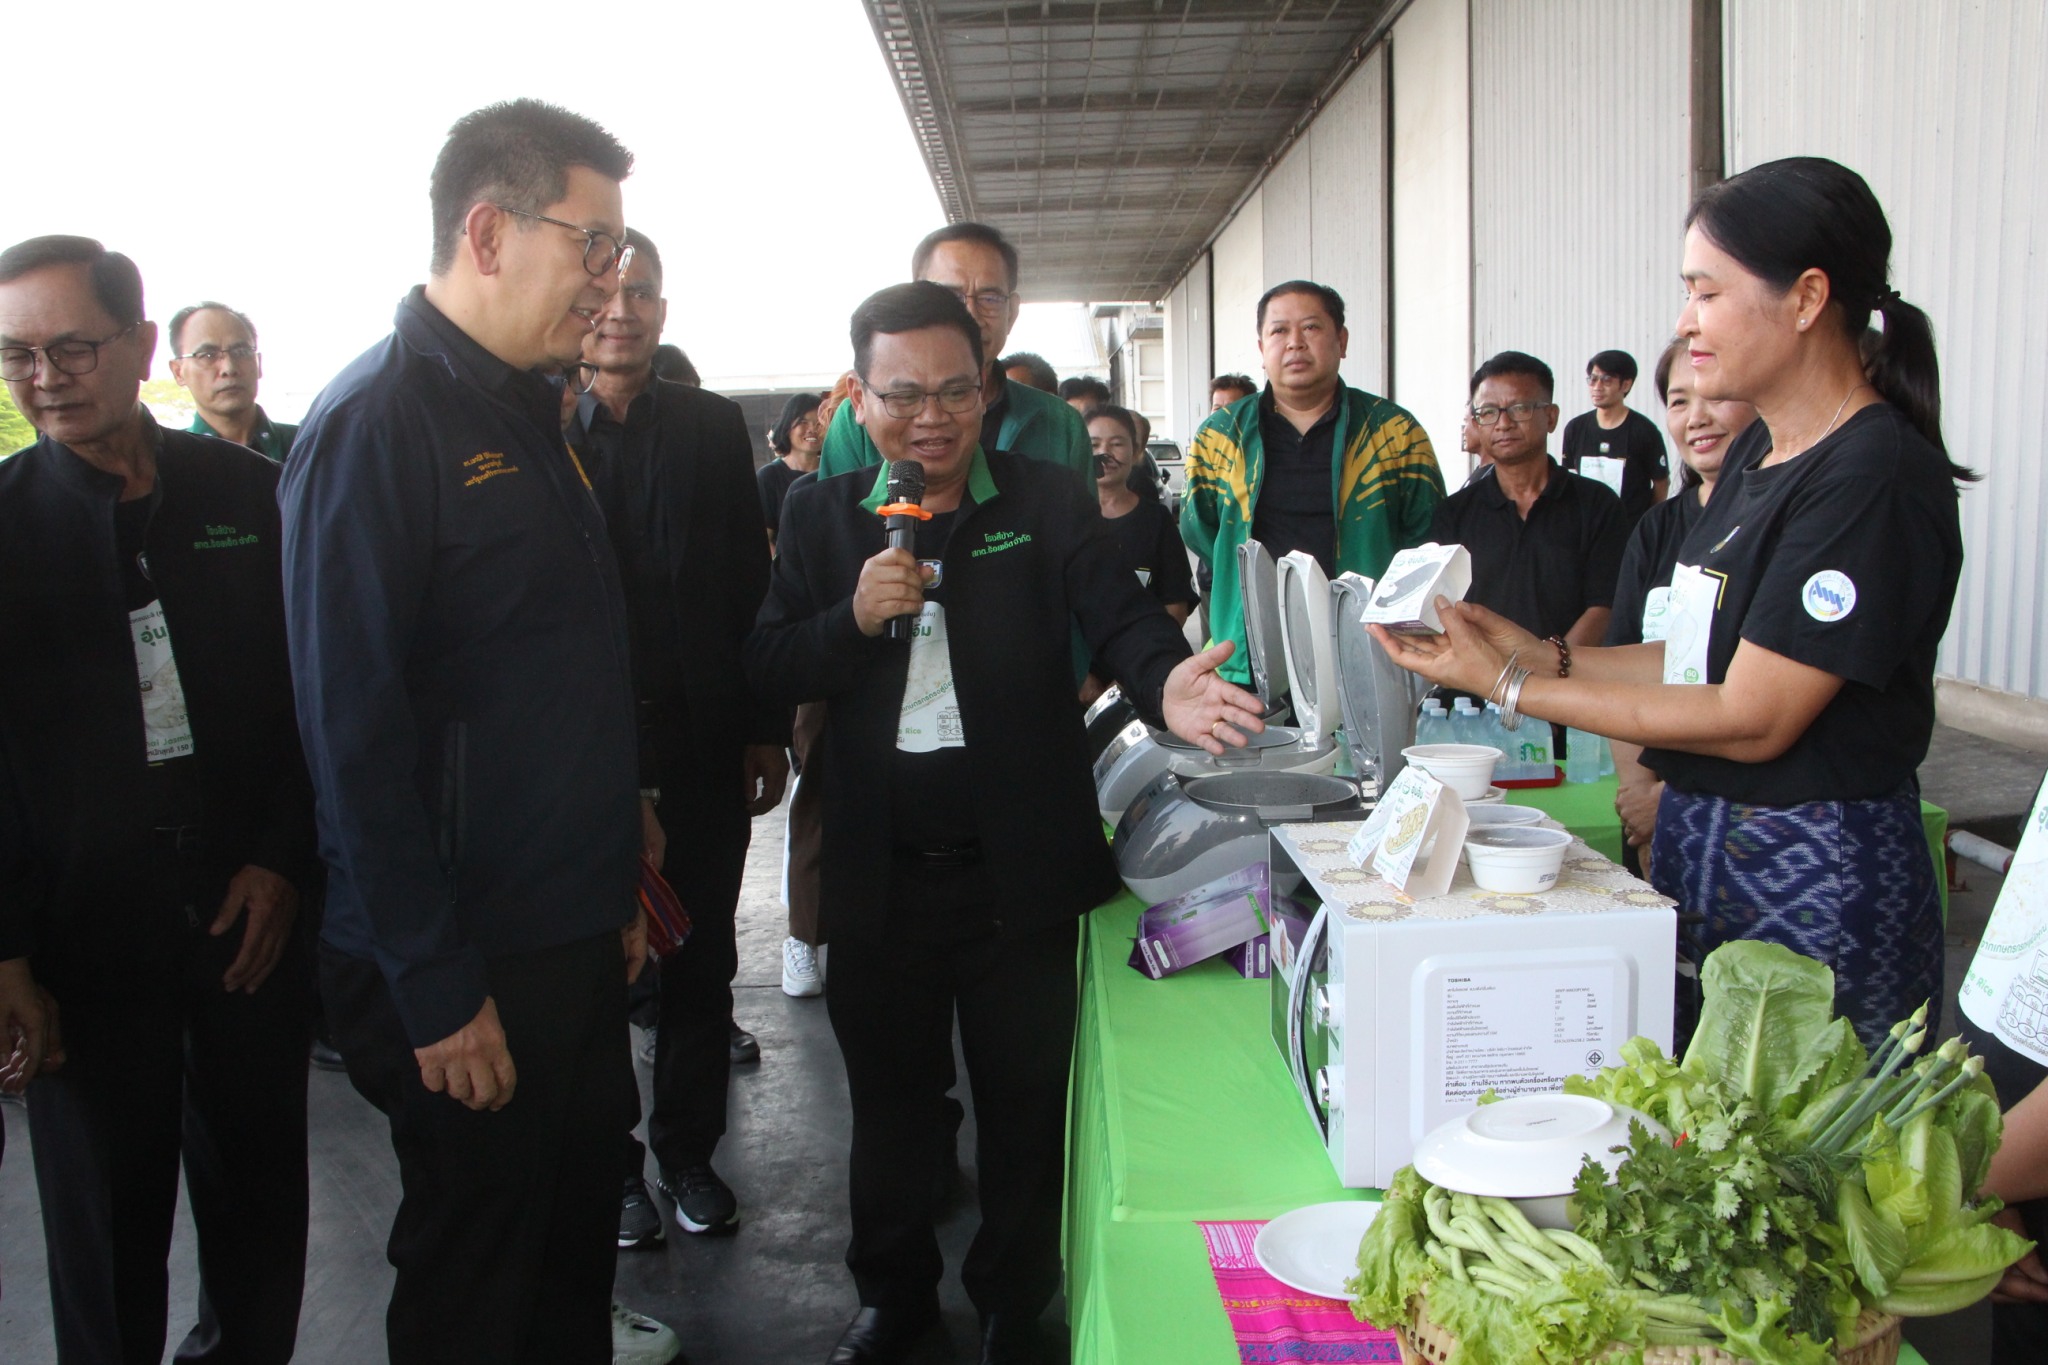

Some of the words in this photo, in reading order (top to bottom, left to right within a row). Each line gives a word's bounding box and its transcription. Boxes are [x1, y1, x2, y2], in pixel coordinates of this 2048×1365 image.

[984, 531, 1014, 543] โรงสีข้าว
[176, 743, 189, 752] 150
[1975, 976, 1994, 997] Rice
[1445, 1080, 1467, 1088] คำเตือน
